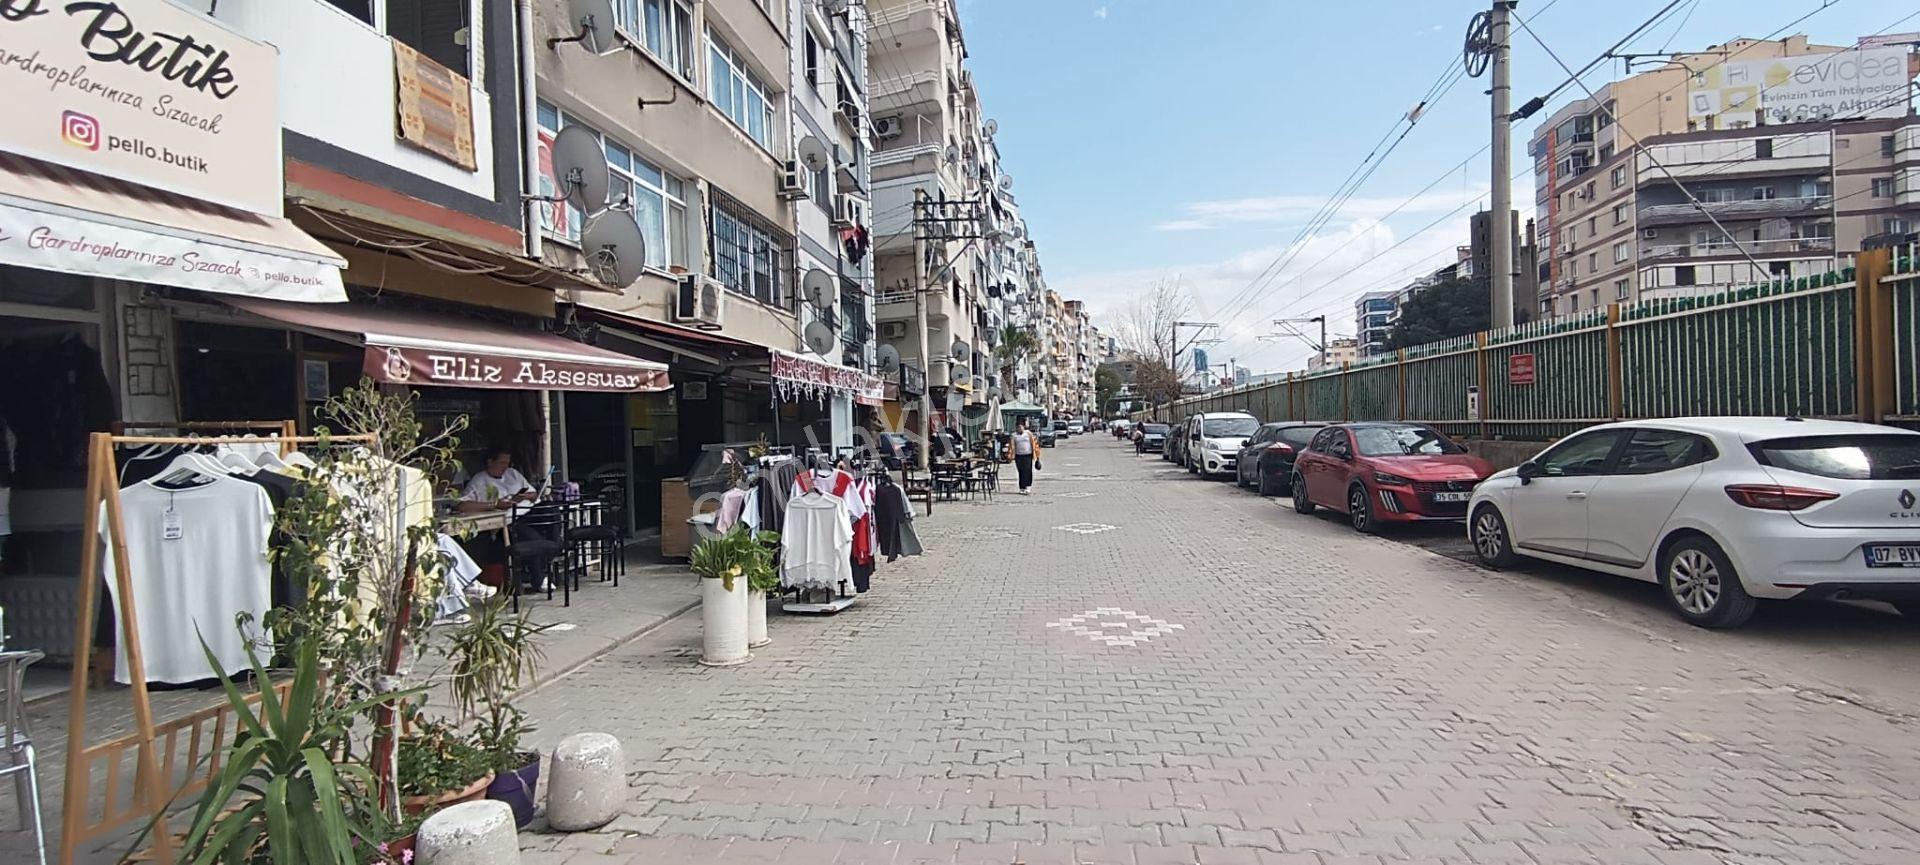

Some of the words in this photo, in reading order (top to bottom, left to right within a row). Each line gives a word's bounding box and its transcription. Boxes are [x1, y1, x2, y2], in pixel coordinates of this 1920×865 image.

[65, 1, 238, 99] Butik
[1794, 56, 1900, 85] evidea
[1762, 90, 1807, 103] Evinizin
[1810, 88, 1836, 99] Tüm
[108, 135, 208, 173] pello.butik
[28, 226, 176, 266] Gardroplarınıza
[182, 252, 243, 279] Sızacak
[264, 272, 324, 286] pello.butik
[428, 355, 502, 382] Eliz
[512, 361, 640, 388] Aksesuar
[1874, 547, 1890, 561] 07
